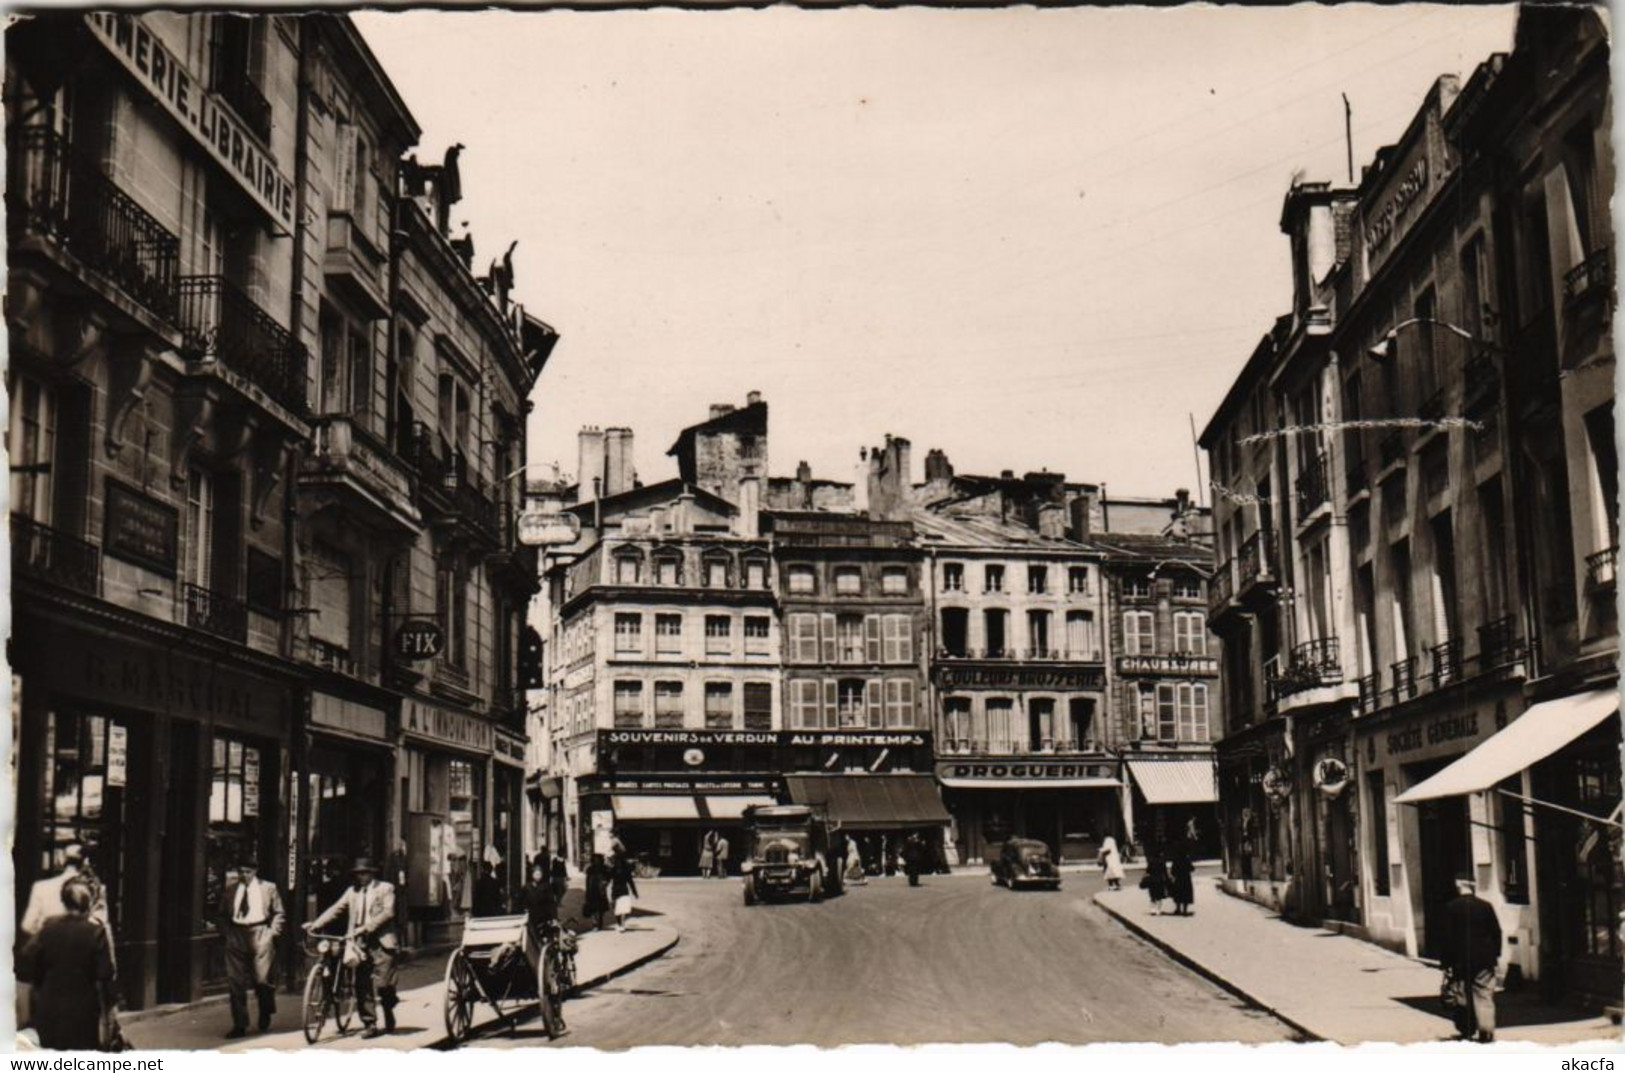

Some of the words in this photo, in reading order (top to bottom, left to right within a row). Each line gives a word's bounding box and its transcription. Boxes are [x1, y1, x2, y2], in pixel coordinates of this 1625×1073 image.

[200, 94, 294, 223] LIBRAIRIE
[402, 632, 437, 653] FIX
[1121, 659, 1218, 671] CHAUSSURES
[609, 732, 698, 743] SOUVENIRS
[714, 733, 778, 743] VERDUN
[791, 734, 814, 745] AU
[821, 734, 924, 745] PRINTEMPS
[954, 765, 1100, 777] DROGUERIE
